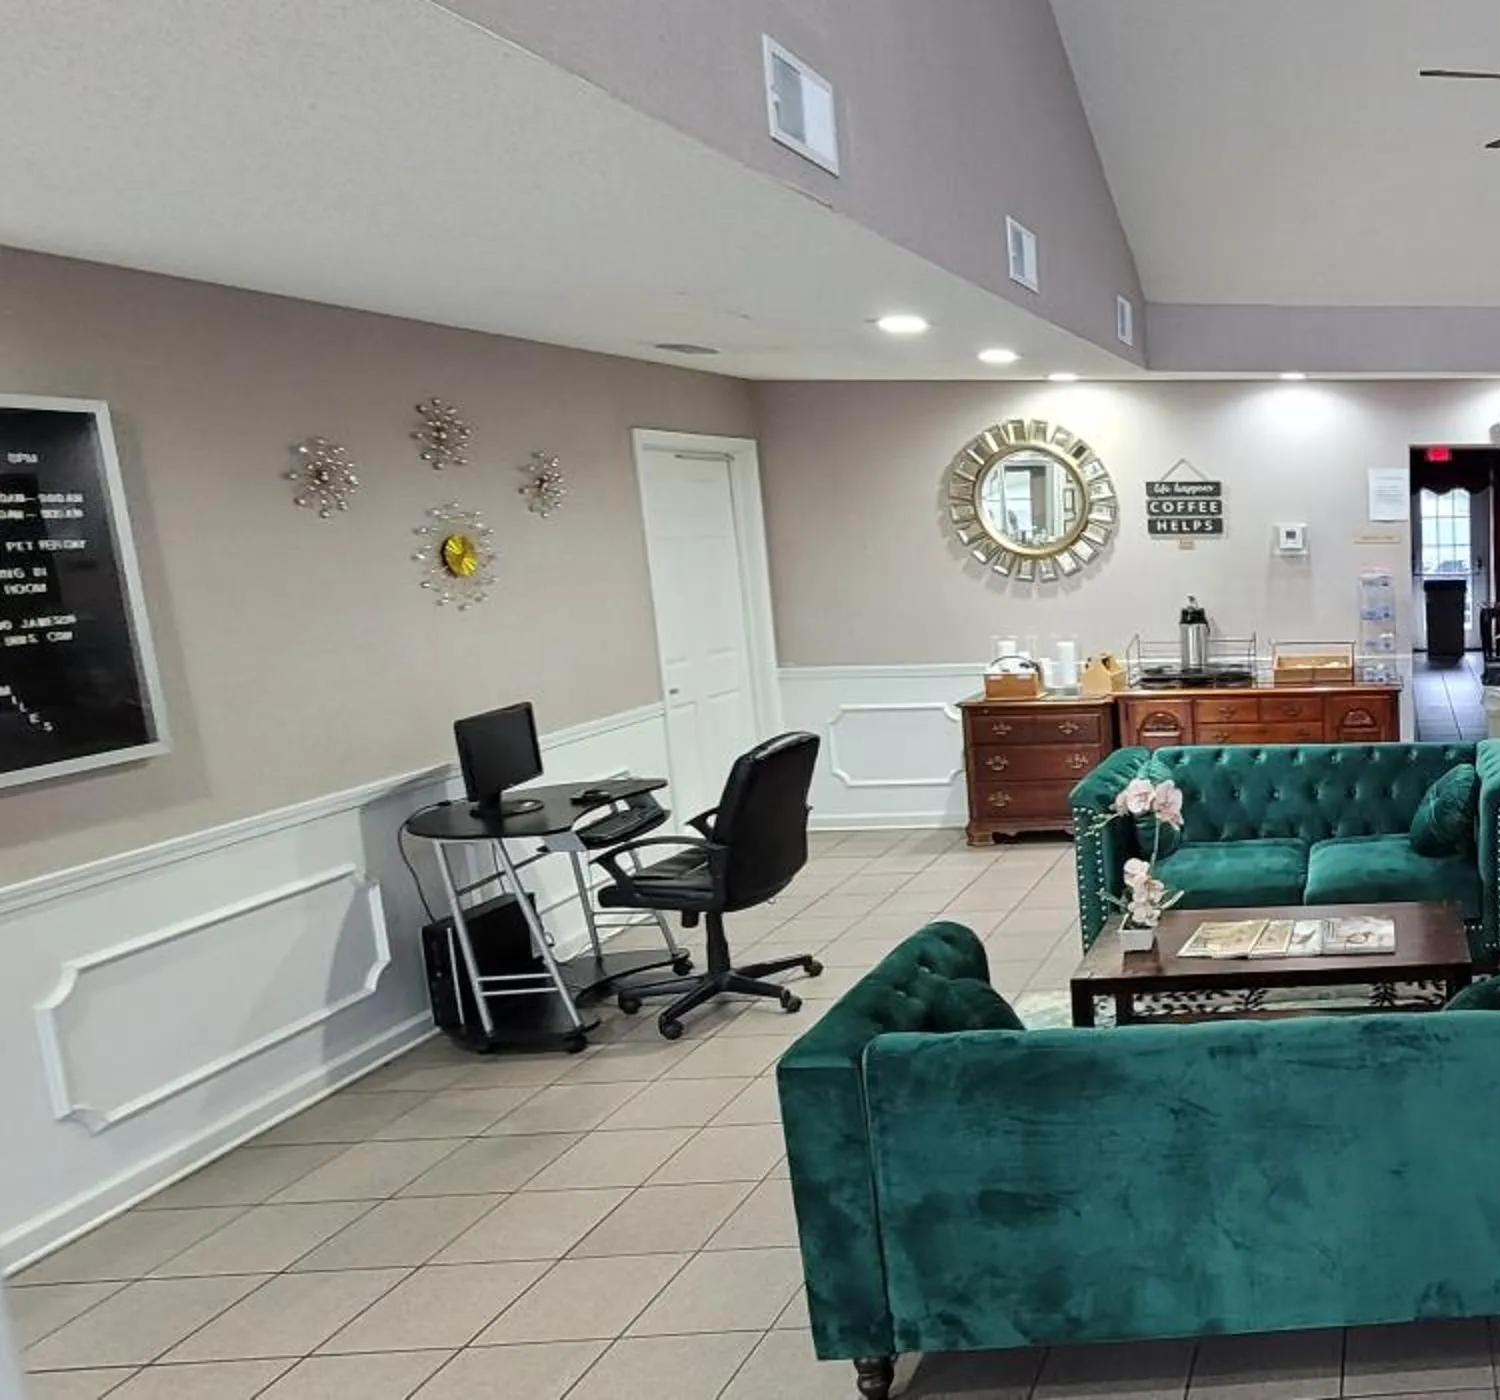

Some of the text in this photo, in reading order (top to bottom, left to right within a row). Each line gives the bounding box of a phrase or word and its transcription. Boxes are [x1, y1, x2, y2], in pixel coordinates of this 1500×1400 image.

[1149, 501, 1219, 513] COFFEE
[1156, 519, 1214, 531] HELPS
[5, 541, 33, 551] PET
[4, 583, 47, 595] ROOM
